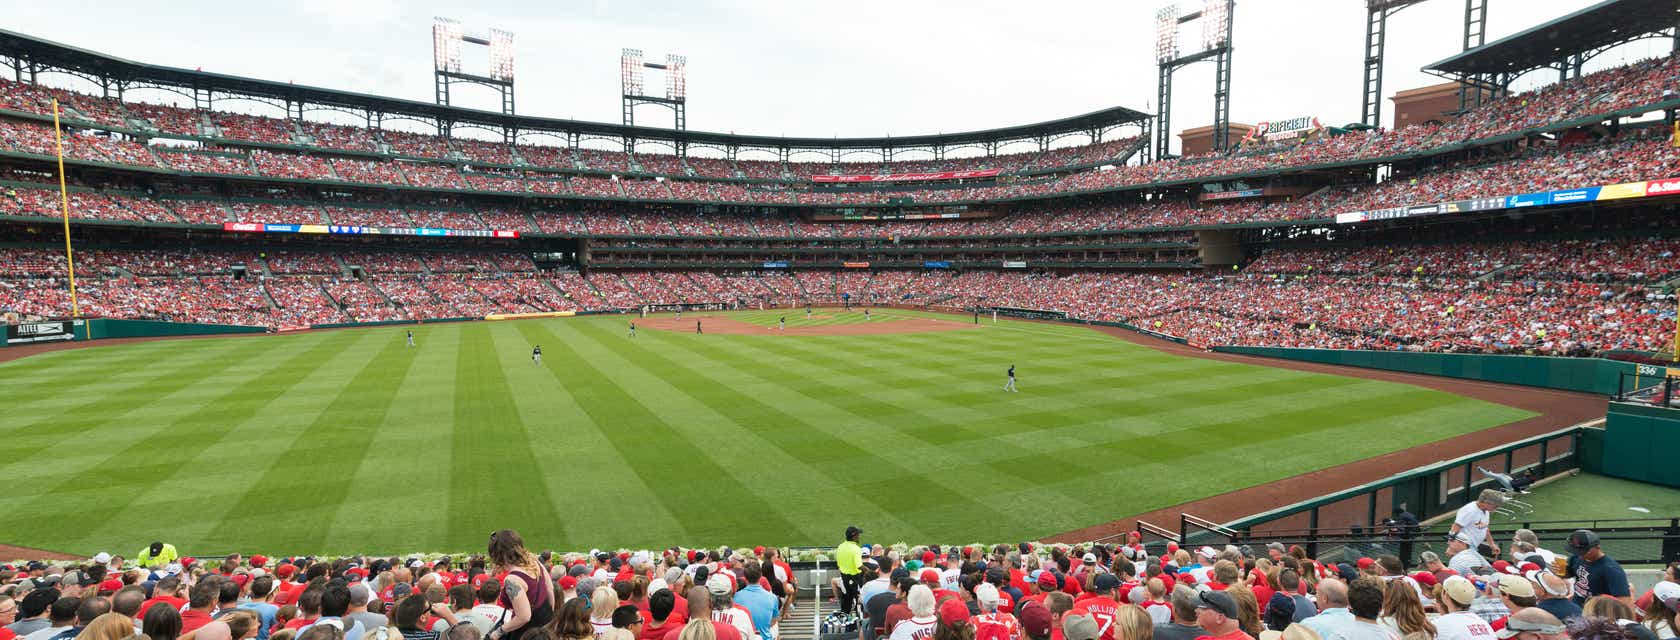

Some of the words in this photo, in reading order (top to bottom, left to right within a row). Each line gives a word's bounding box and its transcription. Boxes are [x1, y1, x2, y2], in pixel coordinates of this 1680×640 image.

[1257, 116, 1311, 136] PERFICIENT
[713, 611, 733, 625] LINA
[1087, 604, 1118, 615] HOLLIDA
[1097, 613, 1113, 639] 7
